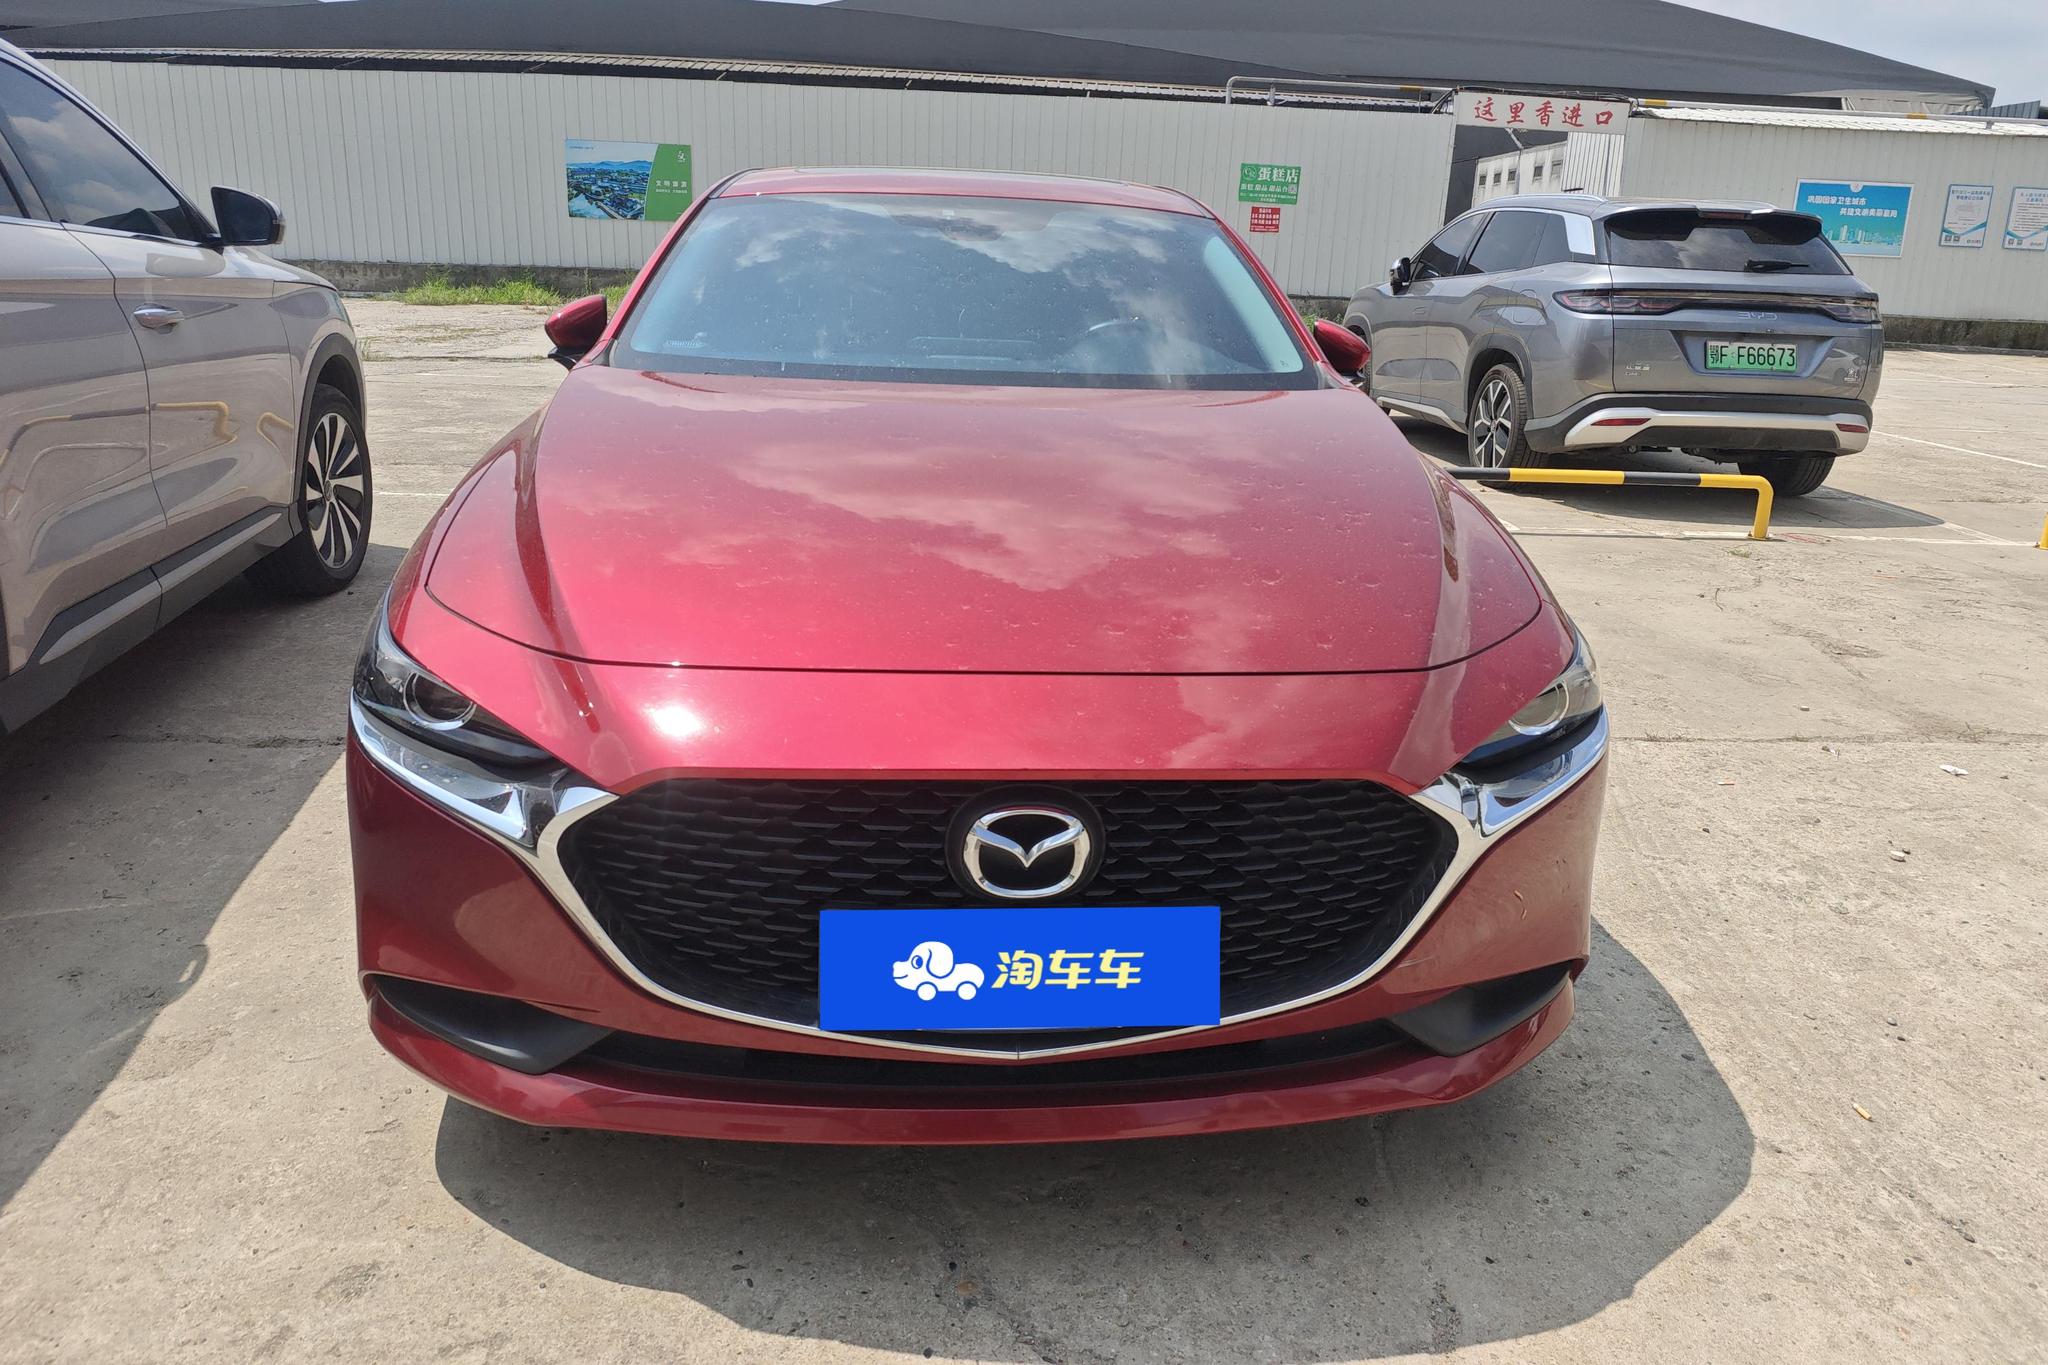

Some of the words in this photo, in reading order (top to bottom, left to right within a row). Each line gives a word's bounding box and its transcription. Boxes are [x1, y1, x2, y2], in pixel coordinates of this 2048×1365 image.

[1474, 96, 1614, 128] 这里香进口
[1257, 167, 1299, 183] 蛋糕店
[1807, 195, 1868, 206] 巩固国家卫生城市
[1709, 344, 1729, 365] 鄂F
[1737, 345, 1796, 367] F66673
